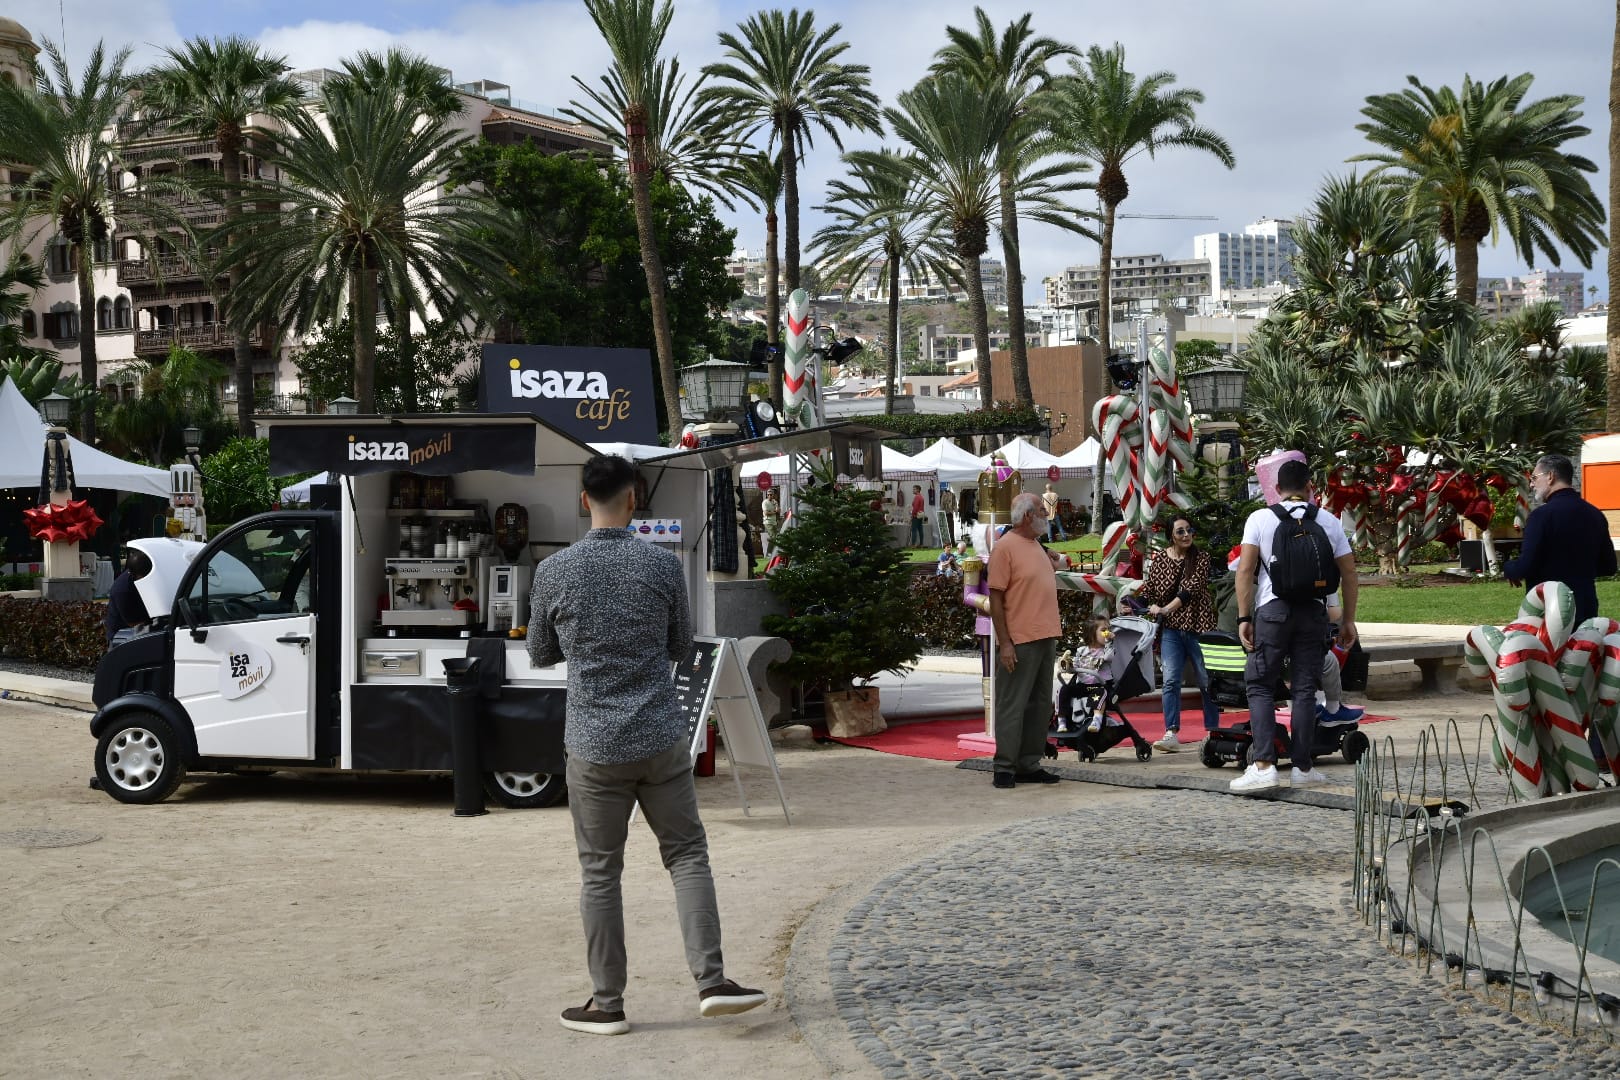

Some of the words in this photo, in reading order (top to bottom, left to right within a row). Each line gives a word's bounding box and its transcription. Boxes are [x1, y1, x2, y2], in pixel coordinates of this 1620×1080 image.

[509, 358, 610, 400] isaza
[575, 388, 632, 430] café
[348, 434, 409, 461] isaza
[410, 432, 452, 466] móvil
[229, 651, 250, 667] isa
[231, 665, 247, 678] za
[238, 665, 264, 691] móvil
